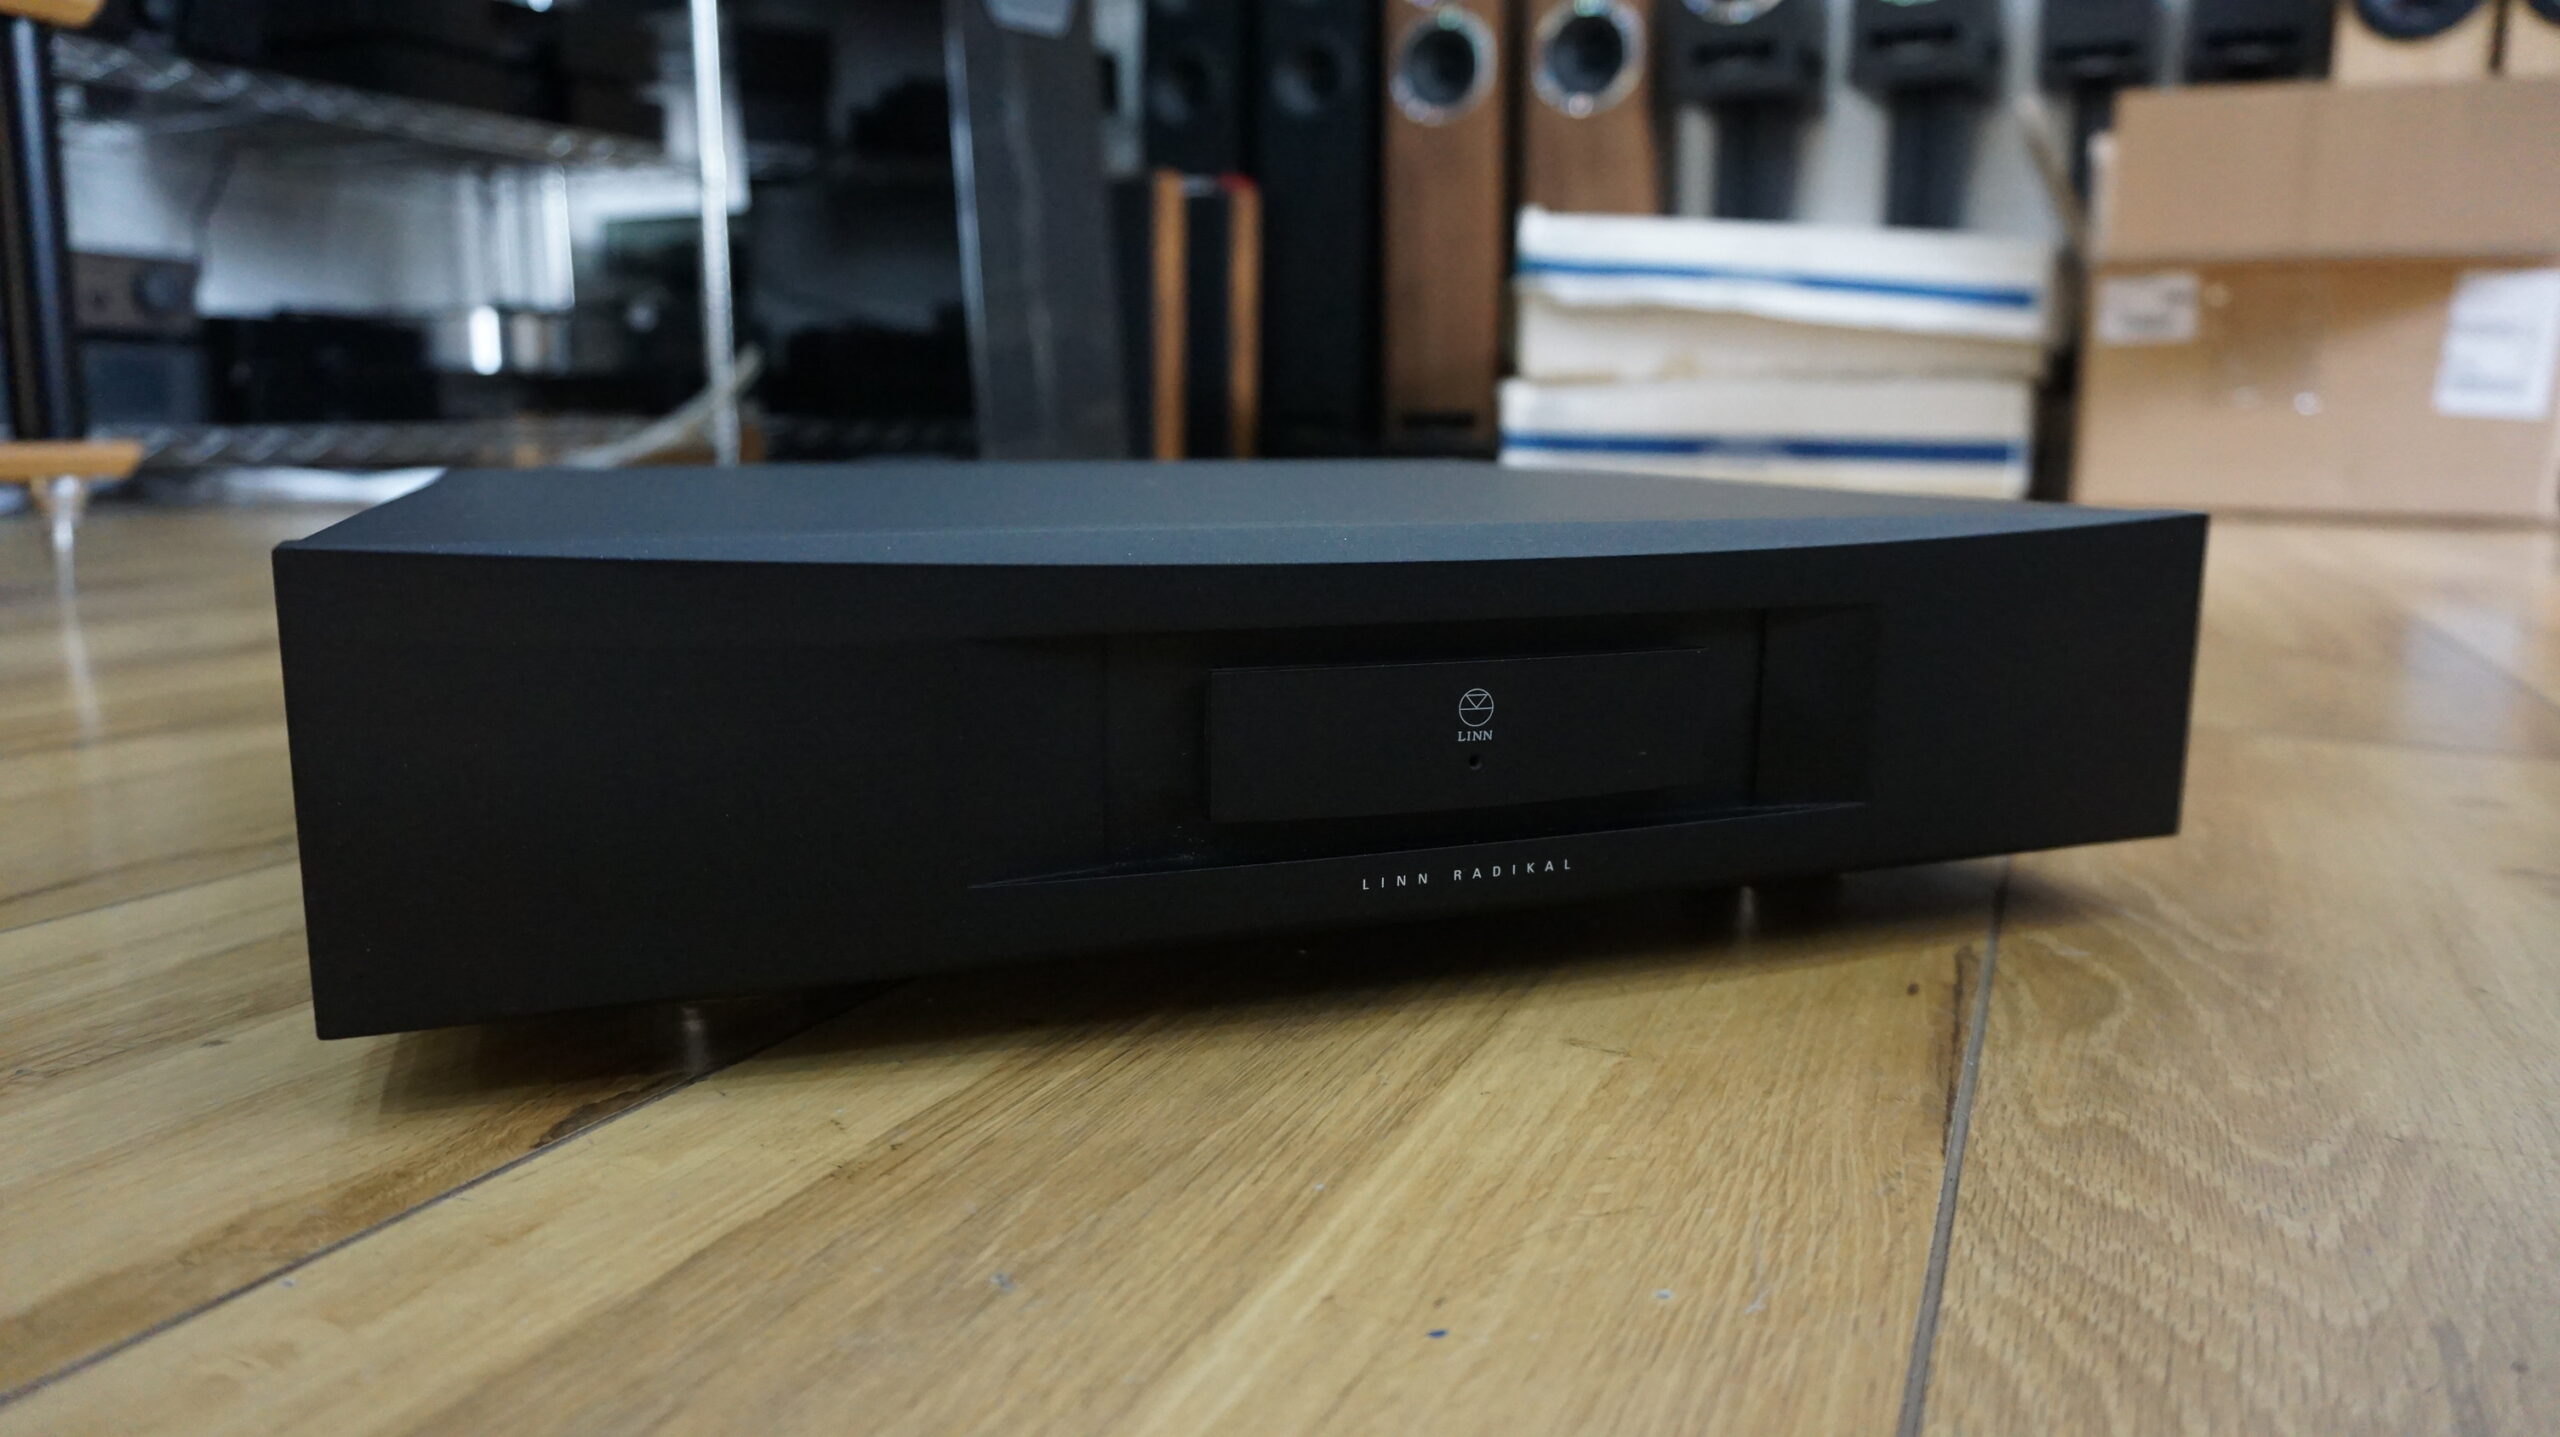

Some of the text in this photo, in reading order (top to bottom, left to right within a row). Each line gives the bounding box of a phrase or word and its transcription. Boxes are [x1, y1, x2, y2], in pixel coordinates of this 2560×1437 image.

[1457, 730, 1493, 742] LINN
[1362, 859, 1571, 890] LINN RADIKAL
